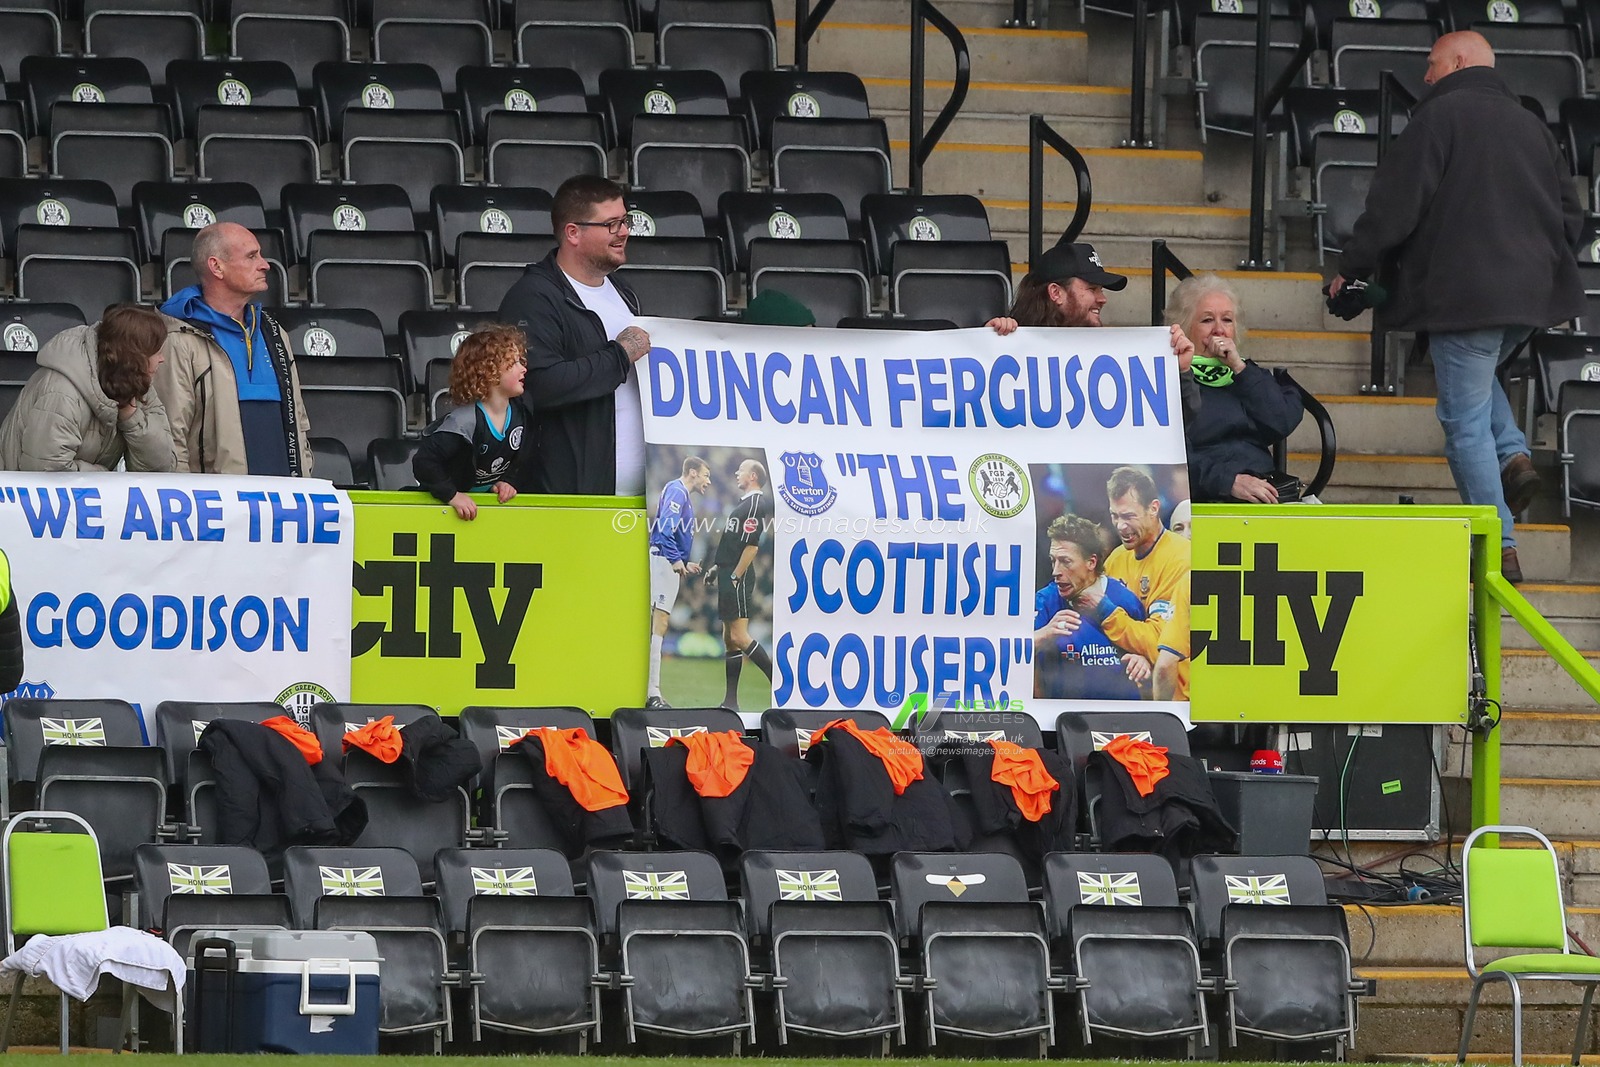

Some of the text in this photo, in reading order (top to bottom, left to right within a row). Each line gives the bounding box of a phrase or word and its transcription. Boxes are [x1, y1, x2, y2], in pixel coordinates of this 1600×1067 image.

[648, 346, 1170, 430] DUNCAN FERGUSON
[288, 431, 298, 468] ZAVETTI
[0, 486, 341, 545] "WE ARE THE
[791, 485, 824, 496] Everton
[835, 452, 966, 522] "THE
[788, 538, 1022, 618] SCOTTISH
[26, 591, 310, 653] GOODISON
[294, 684, 317, 692] GREEN
[773, 631, 1033, 710] SCOUSER!"
[1246, 889, 1267, 897] HOME
